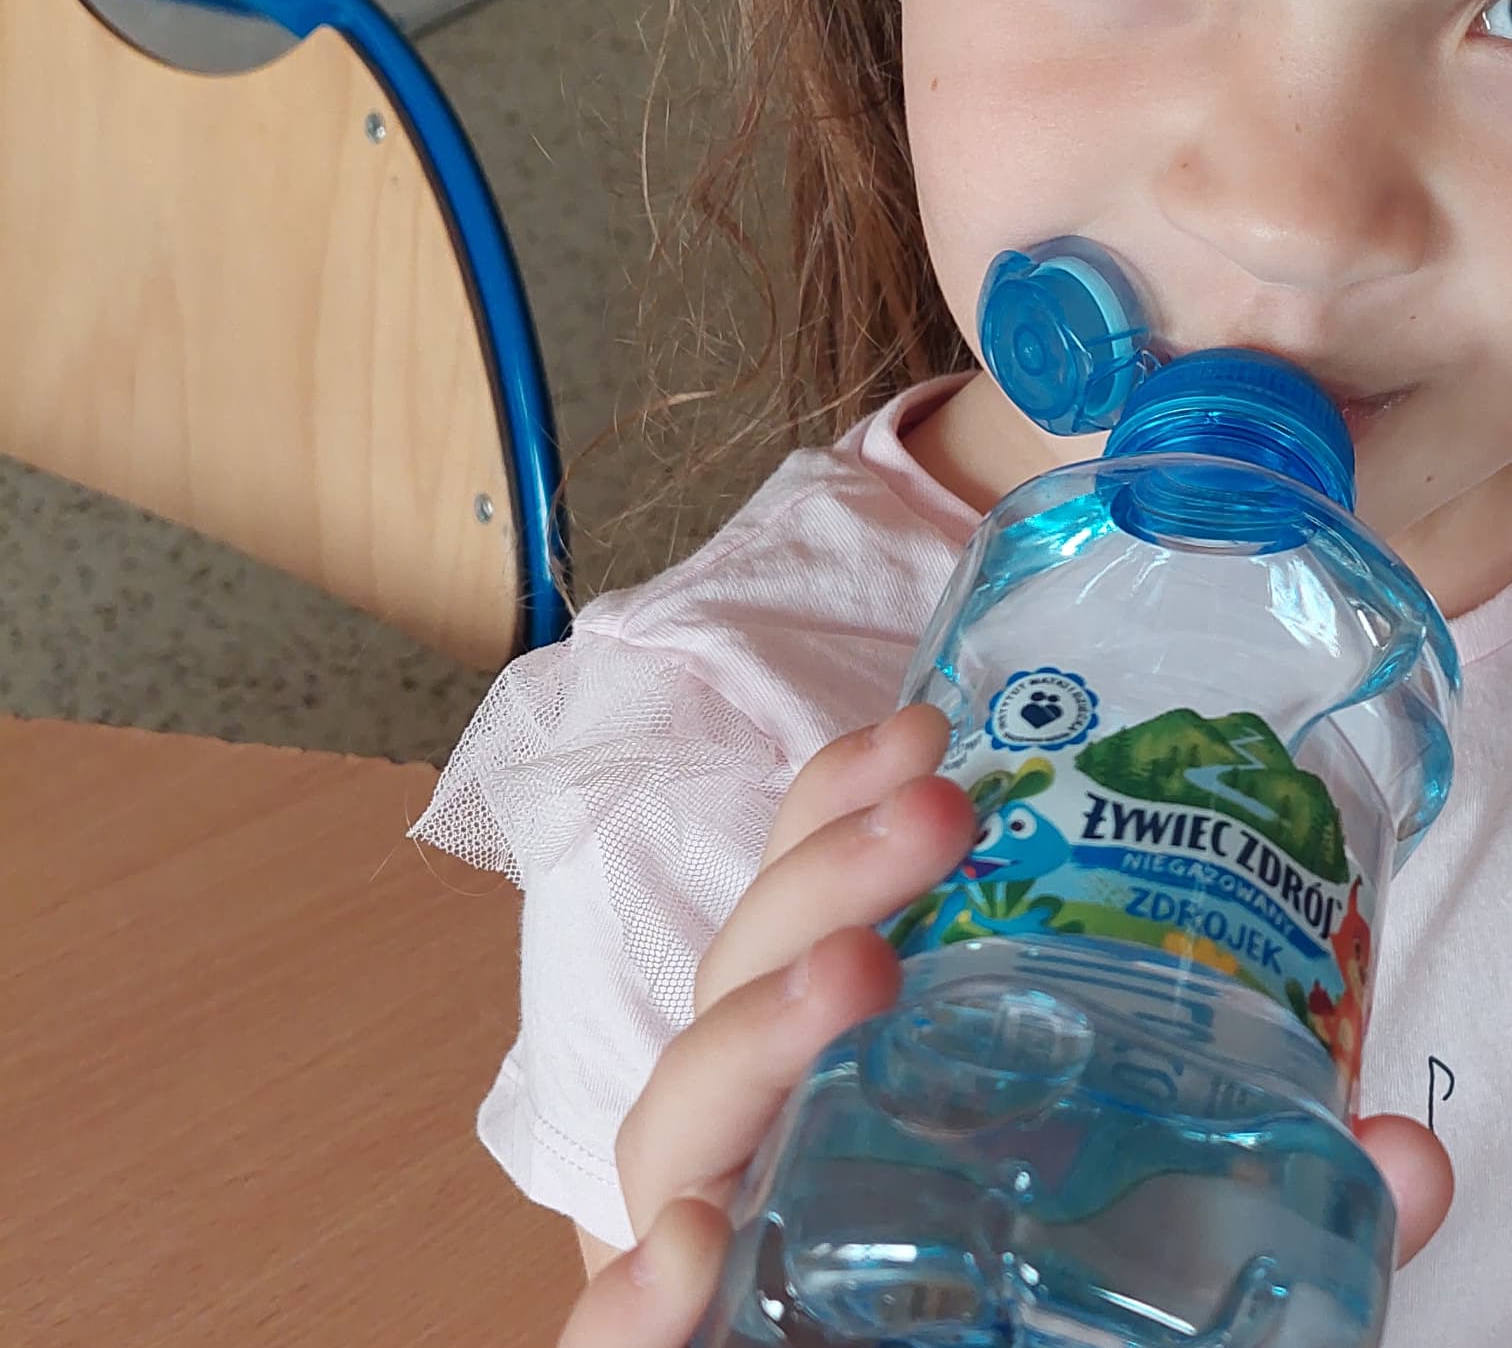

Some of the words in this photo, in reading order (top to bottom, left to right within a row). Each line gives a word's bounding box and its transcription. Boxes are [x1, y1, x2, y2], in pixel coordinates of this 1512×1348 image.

[1081, 789, 1232, 857] ŻYWIEC
[1235, 830, 1337, 939] ZDRÓJ
[1121, 852, 1295, 936] NIEGAZOWANY
[1124, 886, 1284, 975] ZDROJEK
